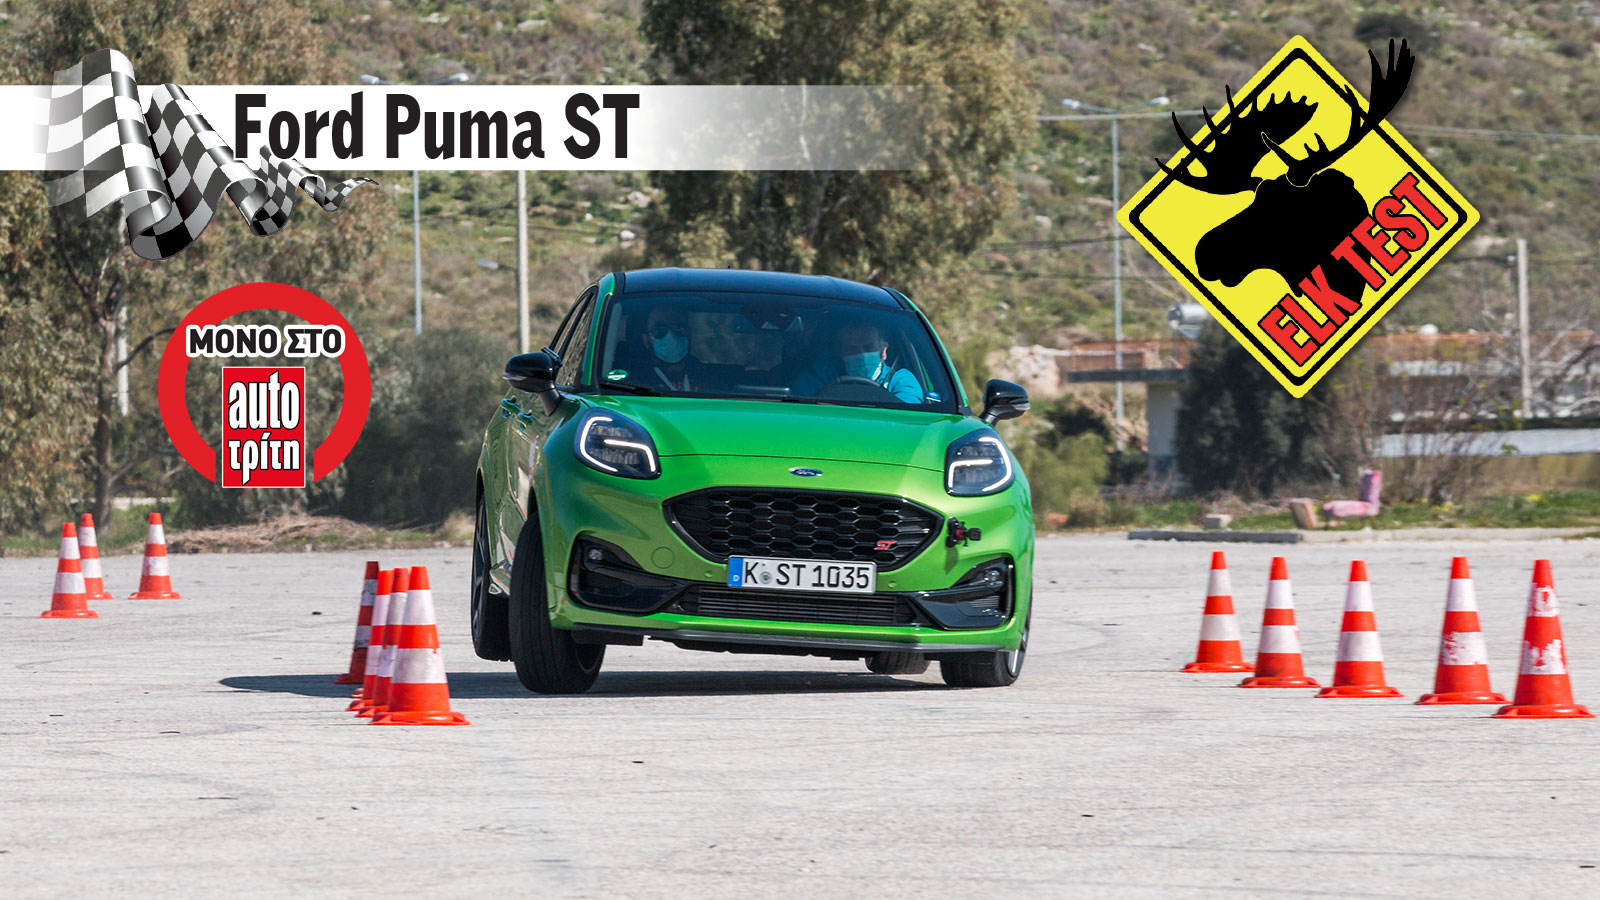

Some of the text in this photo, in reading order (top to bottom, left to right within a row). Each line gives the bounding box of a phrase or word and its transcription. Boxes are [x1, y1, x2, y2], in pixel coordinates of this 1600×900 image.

[874, 540, 897, 551] ST
[744, 561, 759, 584] K
[776, 563, 806, 587] ST
[812, 565, 869, 589] 1035
